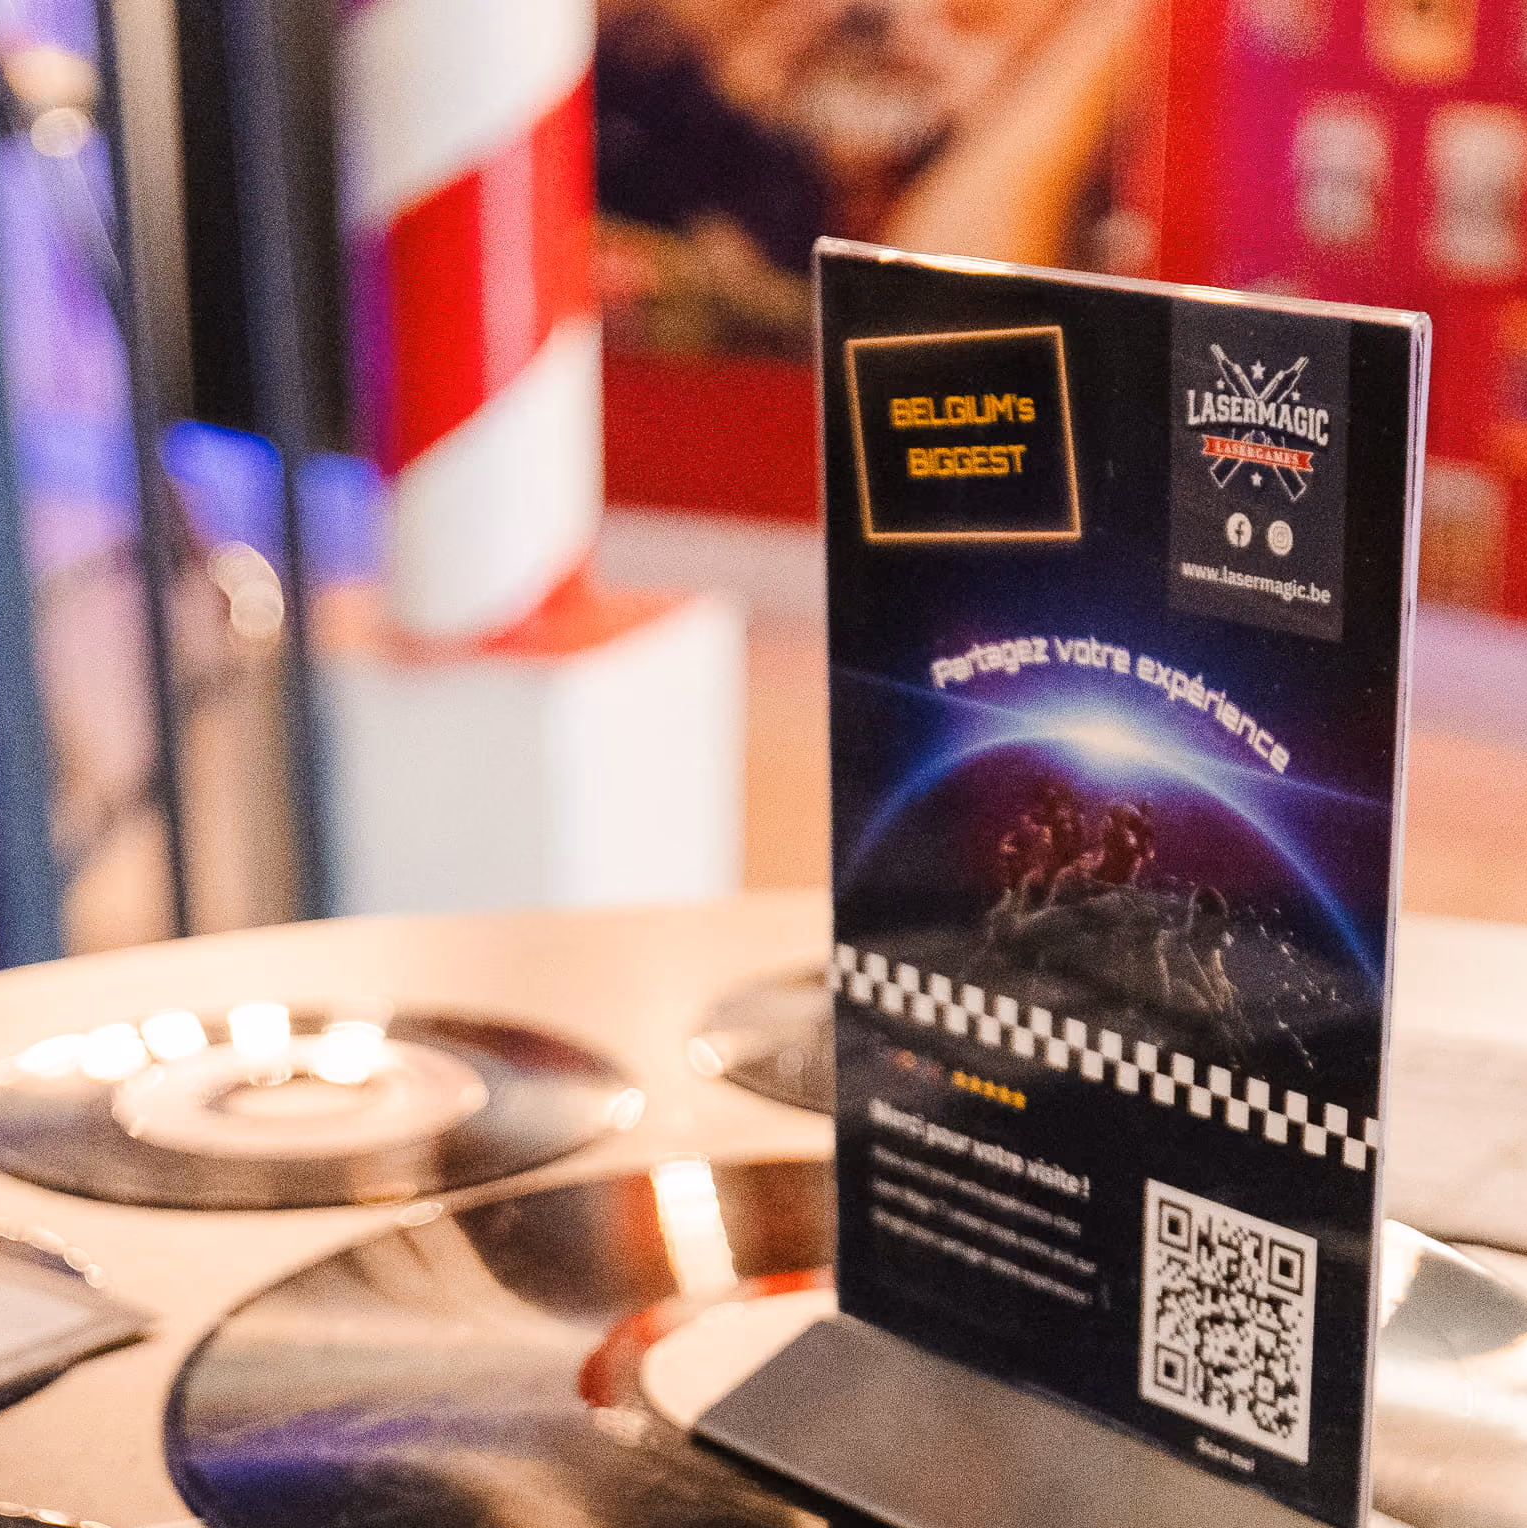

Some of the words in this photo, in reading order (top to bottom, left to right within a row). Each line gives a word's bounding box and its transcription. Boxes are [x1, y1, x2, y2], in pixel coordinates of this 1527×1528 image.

[889, 393, 1035, 430] BELGIUM's
[1186, 389, 1329, 446] LASERMAGIC
[906, 444, 1027, 479] BIGGEST
[1215, 440, 1301, 466] LASERGAMES
[1181, 561, 1331, 604] www.lasermagic.be
[931, 635, 1048, 689] Partagez
[1054, 634, 1131, 676] votre
[1136, 653, 1289, 774] expérience
